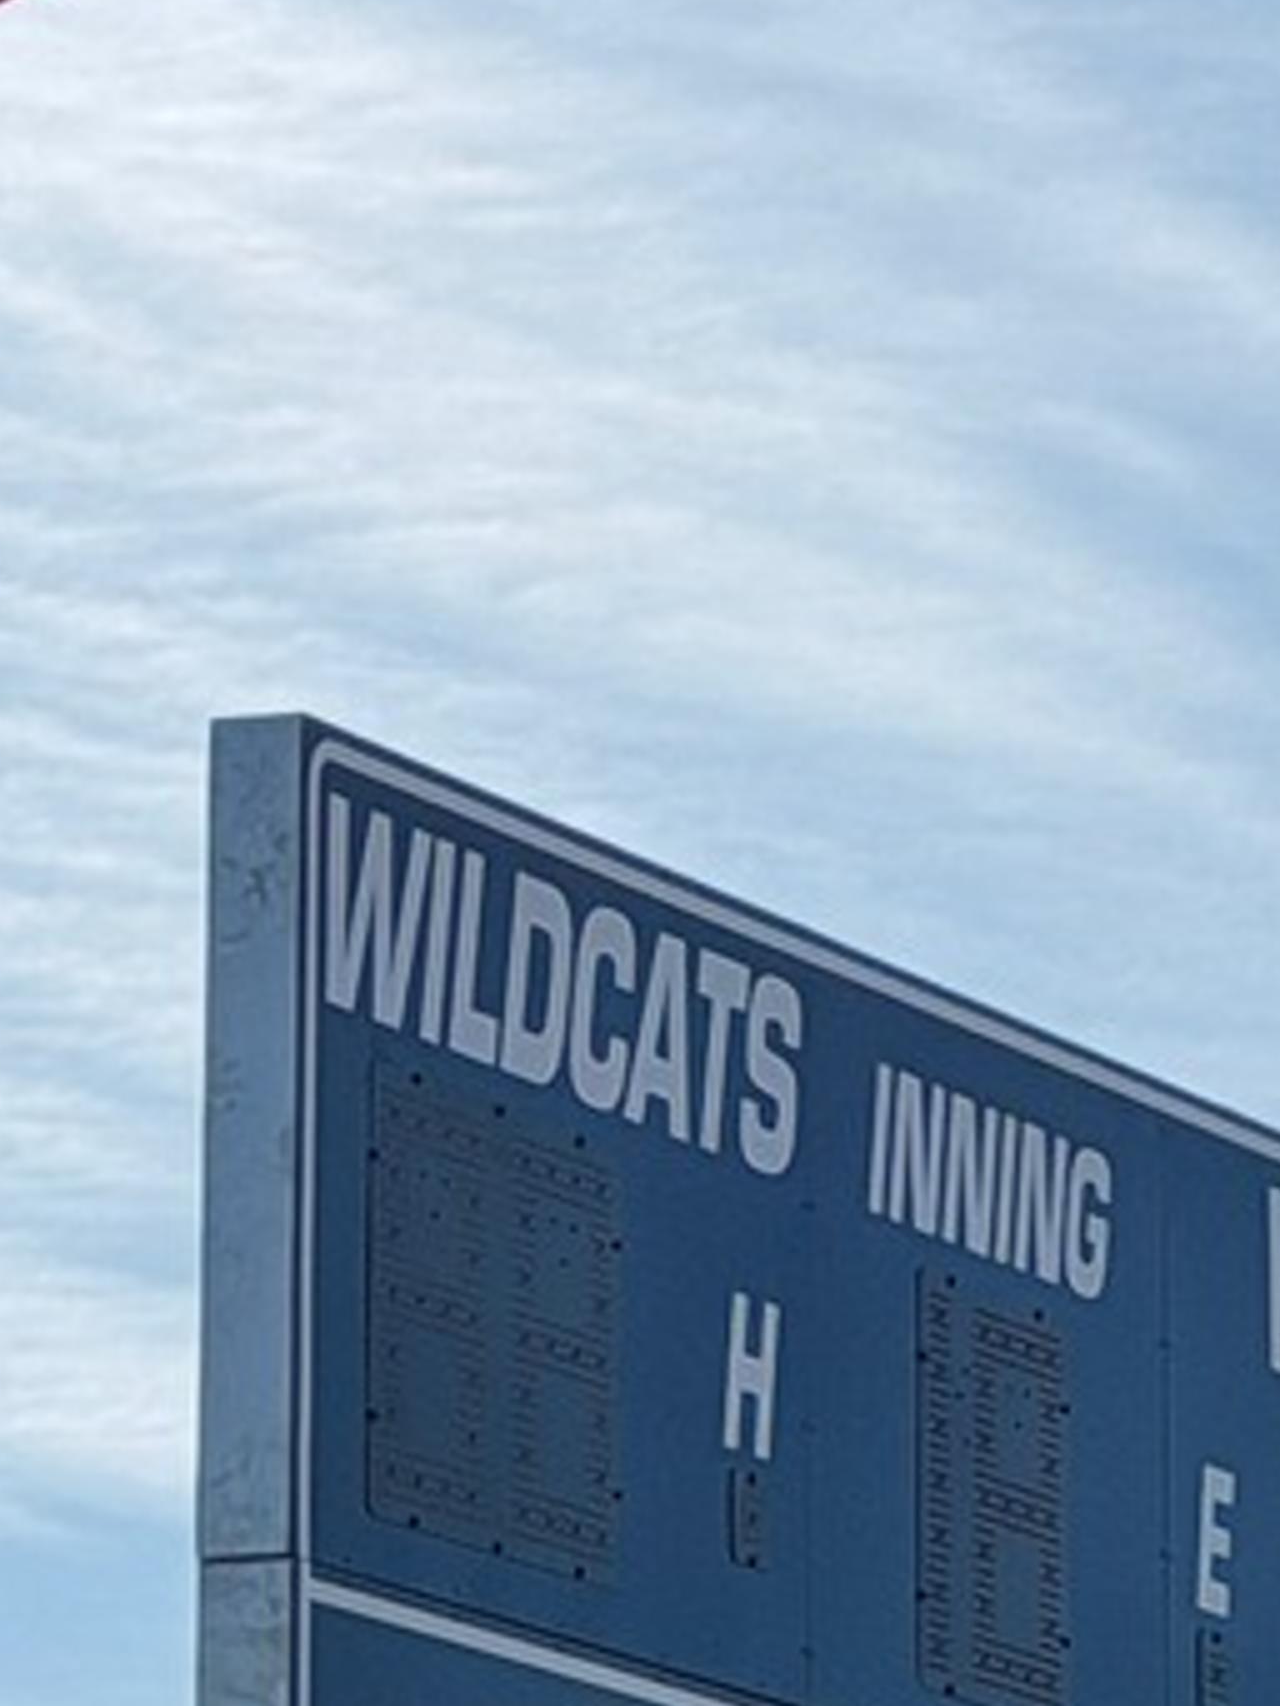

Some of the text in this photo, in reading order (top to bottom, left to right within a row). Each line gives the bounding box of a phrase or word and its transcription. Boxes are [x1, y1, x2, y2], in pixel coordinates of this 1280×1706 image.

[324, 791, 804, 1175] WILDCATS
[867, 1062, 1112, 1299] INNING
[723, 1291, 780, 1459] H
[1196, 1463, 1236, 1617] E
